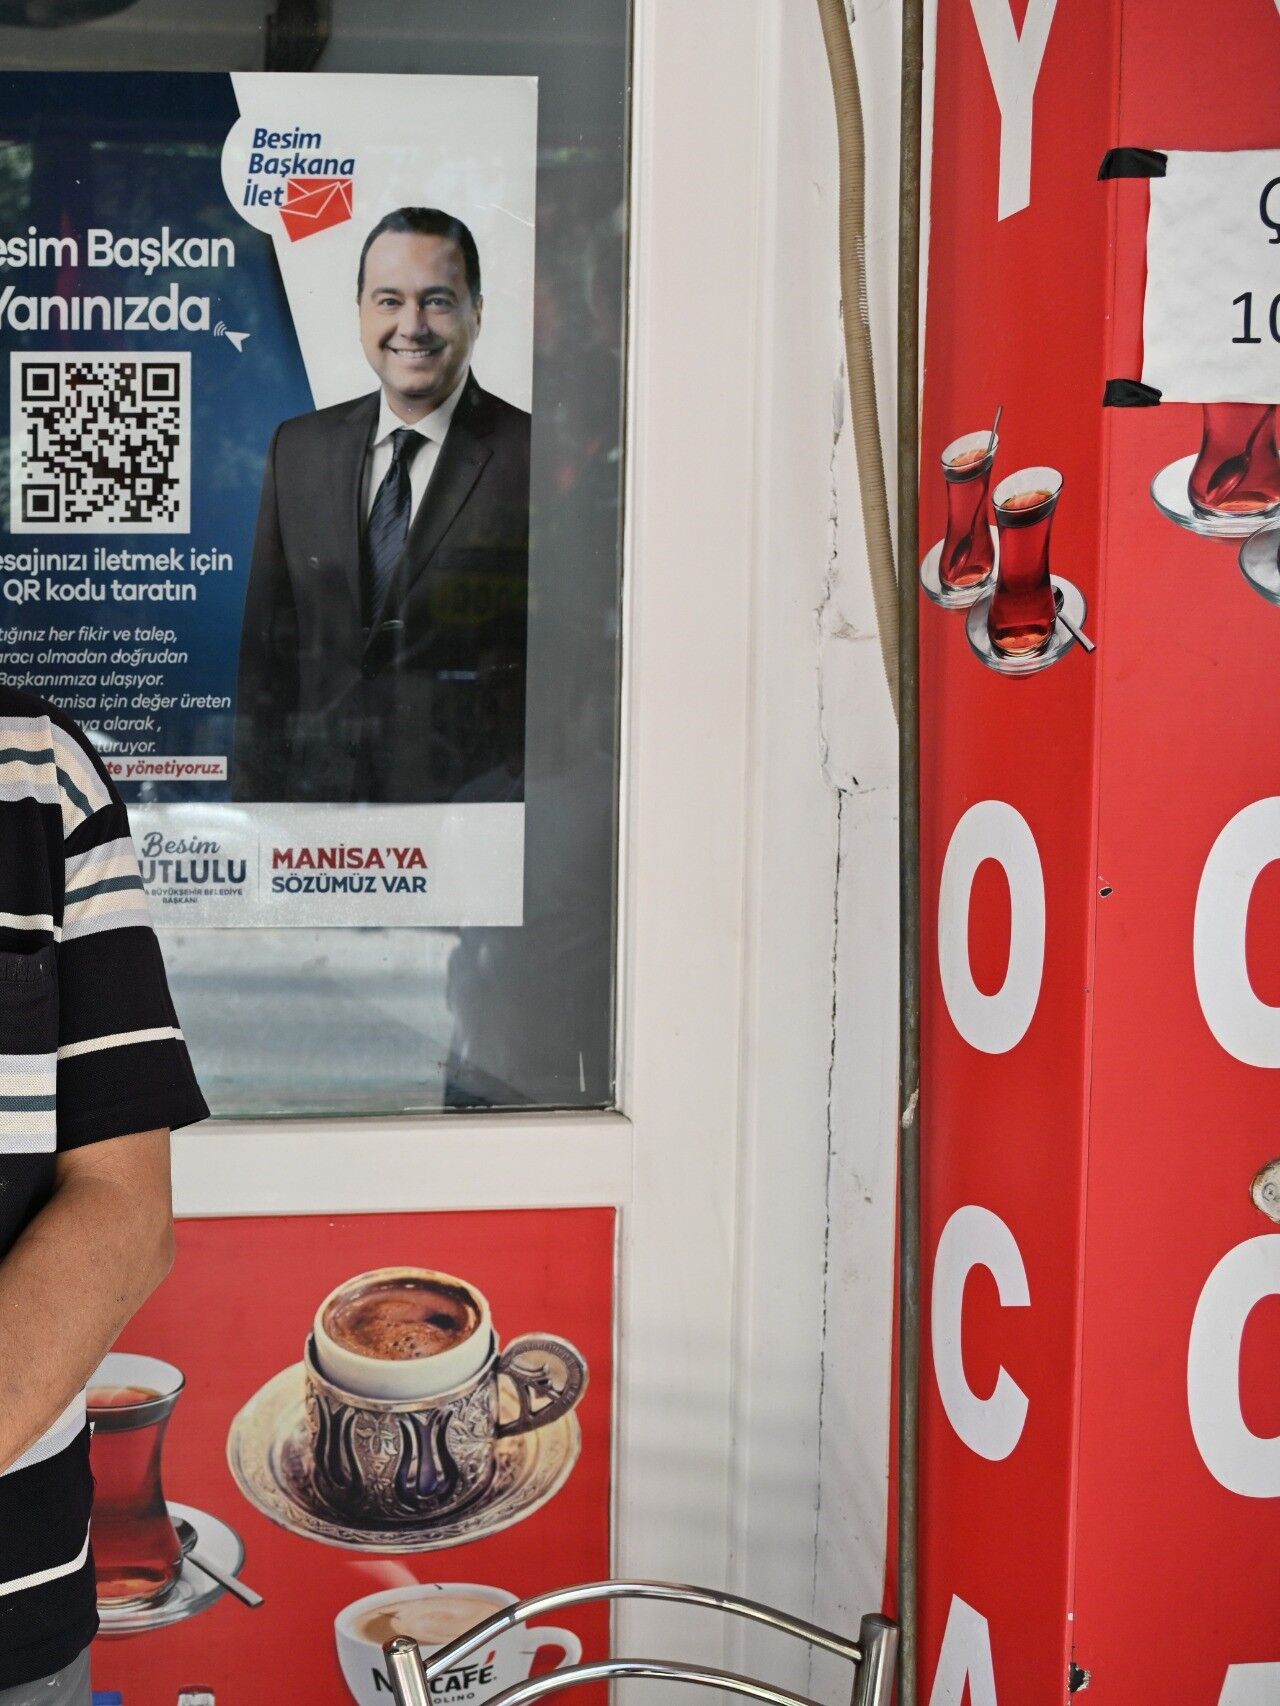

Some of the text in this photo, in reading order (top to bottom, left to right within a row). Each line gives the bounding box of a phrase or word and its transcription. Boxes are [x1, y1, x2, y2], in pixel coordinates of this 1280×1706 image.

[252, 127, 322, 149] Besim
[248, 153, 355, 178] Başkana
[242, 178, 284, 207] İlet
[87, 226, 235, 275] Başkan
[94, 547, 185, 571] iletmek
[190, 547, 233, 575] için
[3, 578, 197, 605] QR kodu taratın
[48, 627, 74, 642] her
[78, 627, 109, 642] fikir
[112, 630, 131, 642] ve
[134, 627, 178, 646] talep,
[37, 649, 107, 664] olmadan
[110, 648, 188, 667] doğrudan
[100, 673, 164, 689] ulaşıyor.
[100, 693, 128, 711] için
[130, 692, 177, 712] değer
[180, 694, 231, 708] üreten
[104, 717, 154, 731] alarak
[126, 760, 224, 778] yönetiyoruz.
[142, 831, 221, 857] Besim
[272, 844, 428, 869] MANİSA'YA
[139, 859, 247, 885] UTLULU
[272, 872, 427, 893] SÖZÜMÜZ VAR
